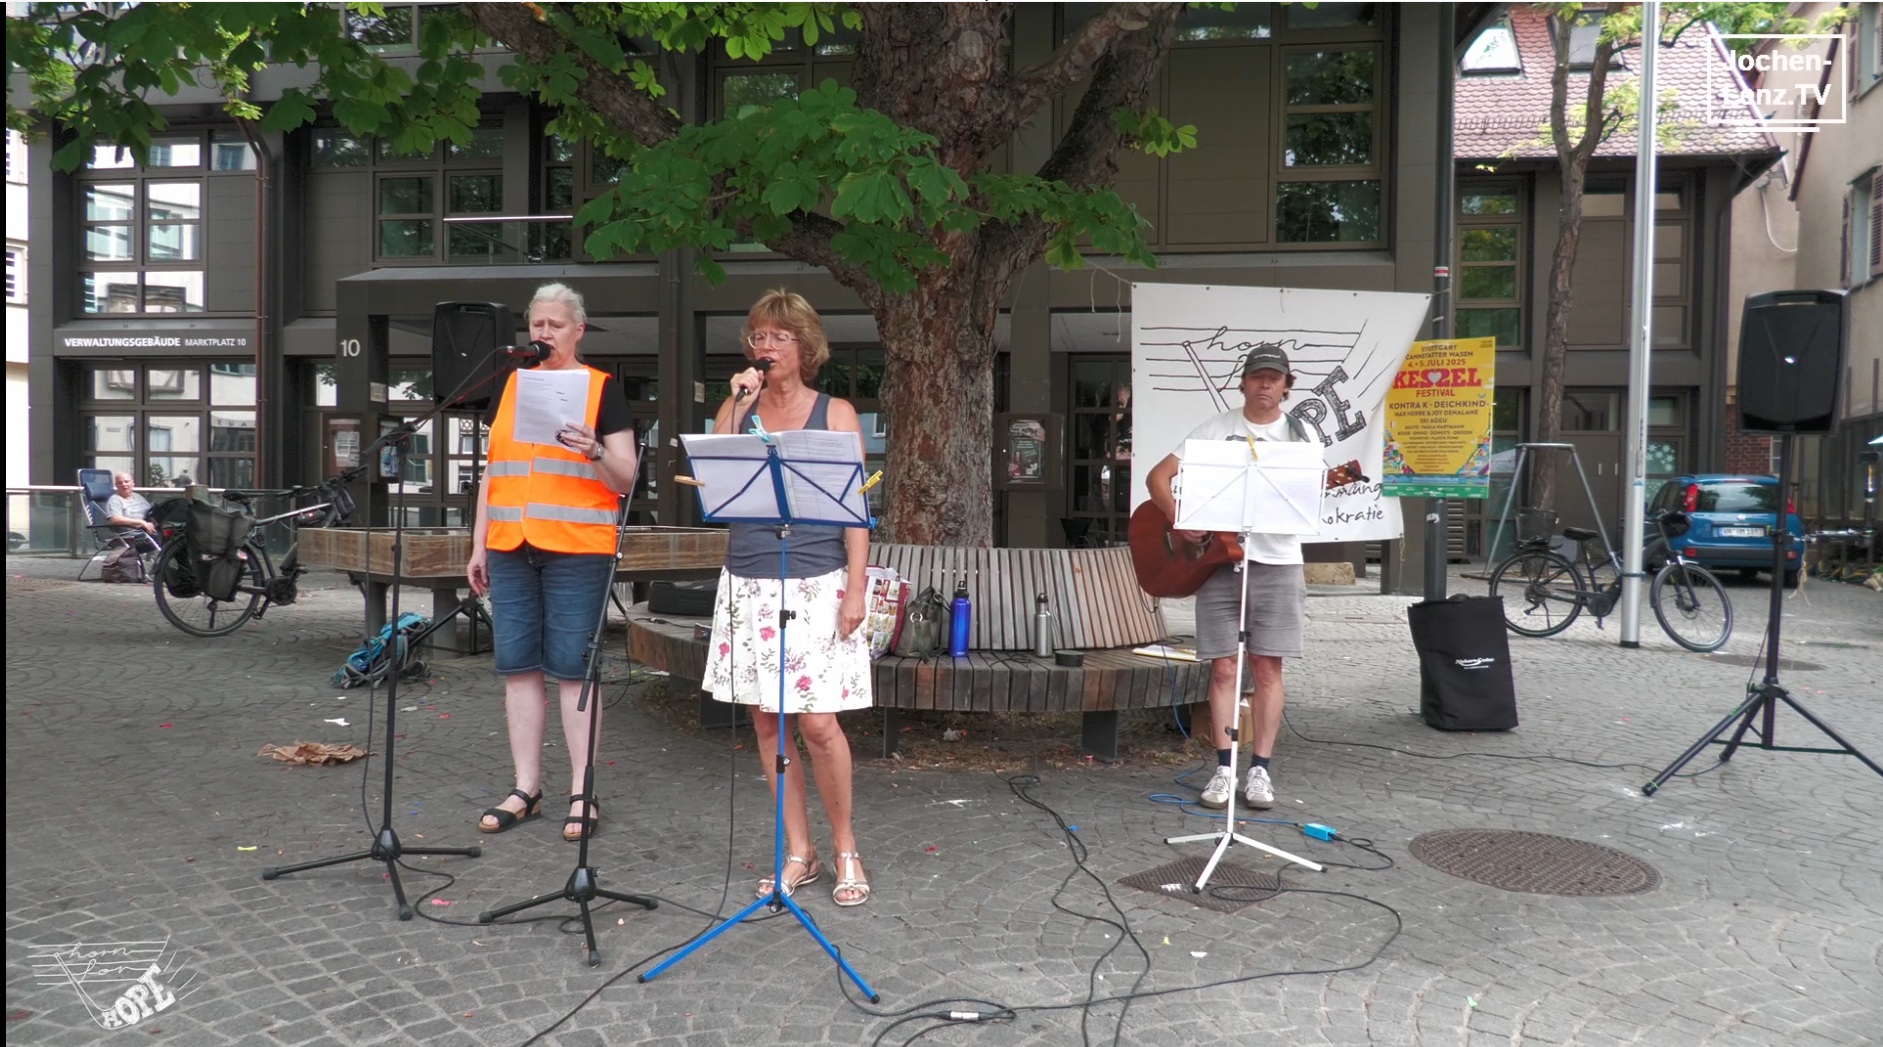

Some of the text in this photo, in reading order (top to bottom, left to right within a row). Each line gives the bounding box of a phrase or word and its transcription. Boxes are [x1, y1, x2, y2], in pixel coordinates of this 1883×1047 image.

[64, 336, 247, 347] VERWALTUNGSGEBÄUDE MARKTPLATZ 10
[340, 339, 361, 357] 10
[1405, 352, 1448, 360] CANNSTATTER
[1416, 389, 1455, 397] FESTIVAL
[1434, 400, 1486, 408] DEICHKIND
